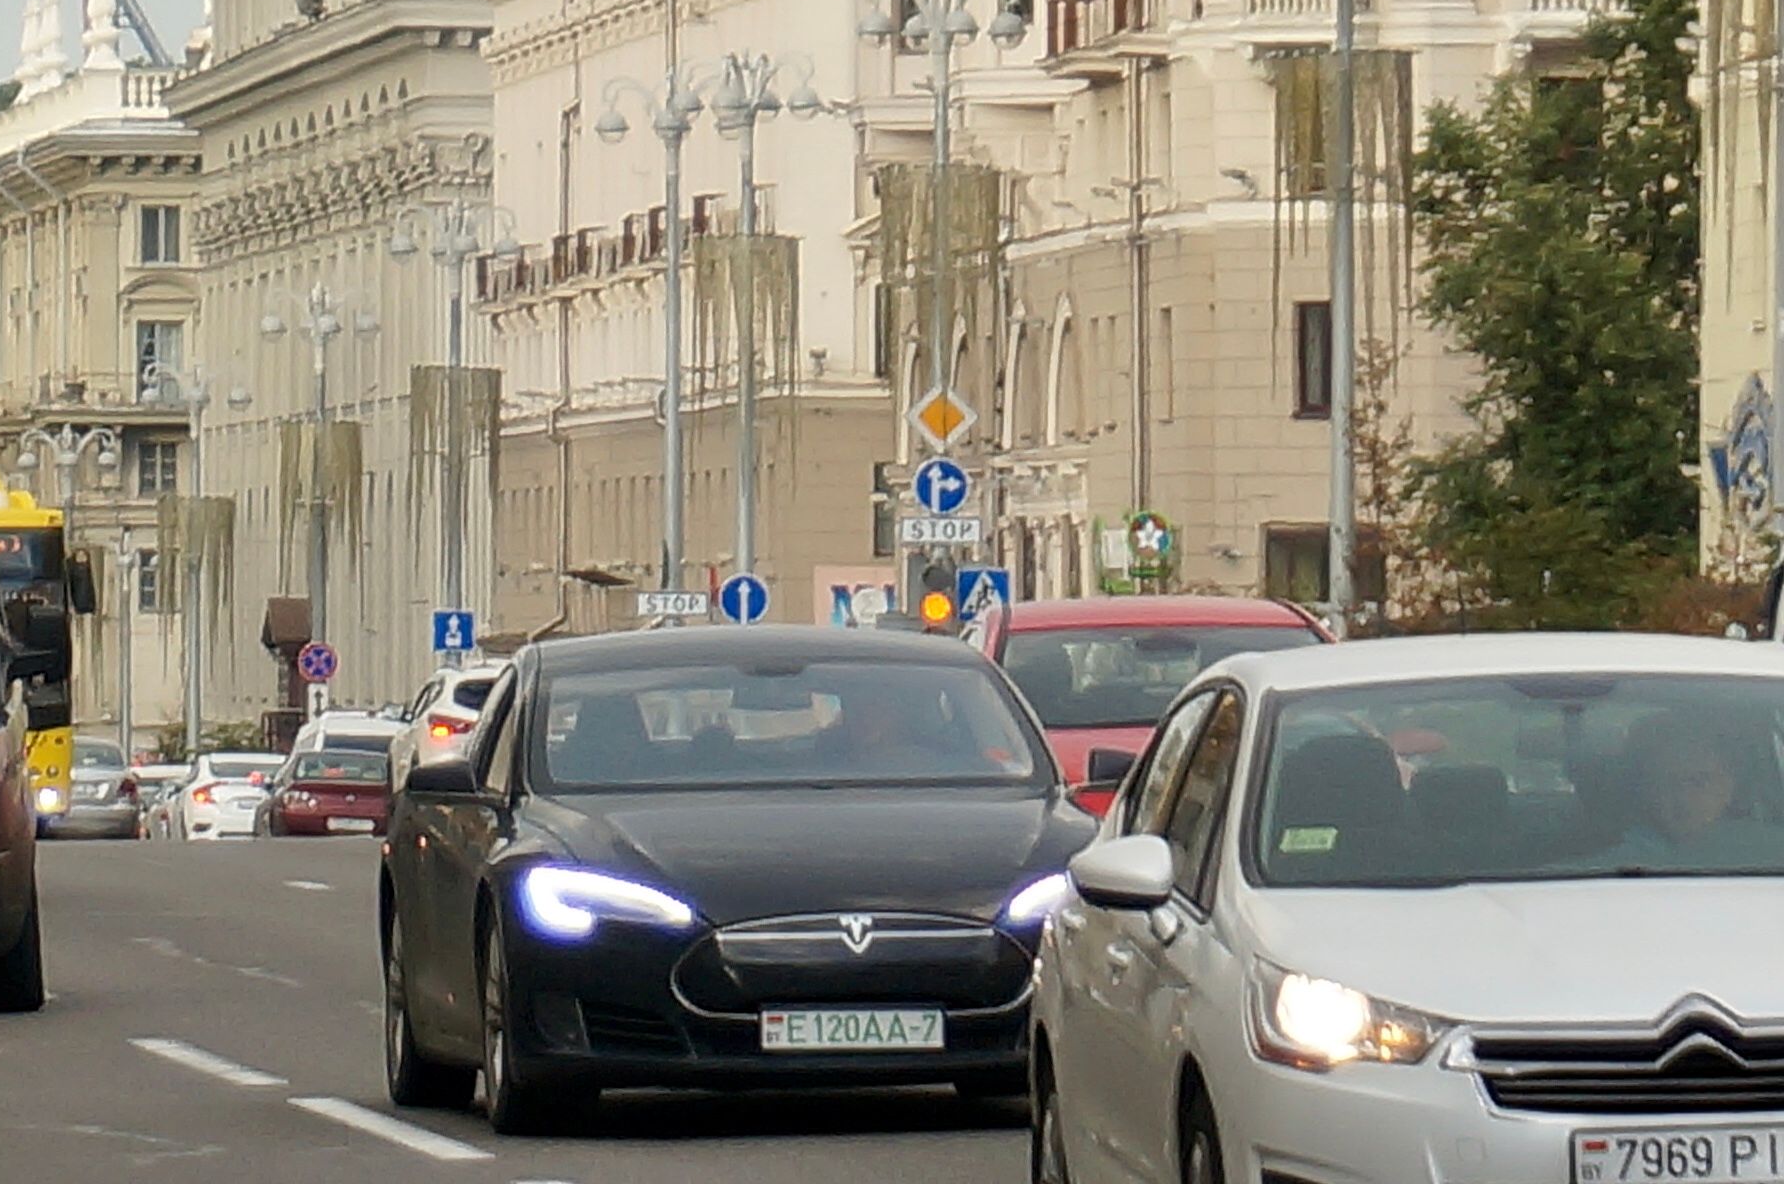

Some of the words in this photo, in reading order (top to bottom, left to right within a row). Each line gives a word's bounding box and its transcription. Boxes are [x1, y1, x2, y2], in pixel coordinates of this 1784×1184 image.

[911, 520, 972, 539] STOP
[647, 595, 699, 613] STOP
[1617, 1137, 1713, 1180] 7969
